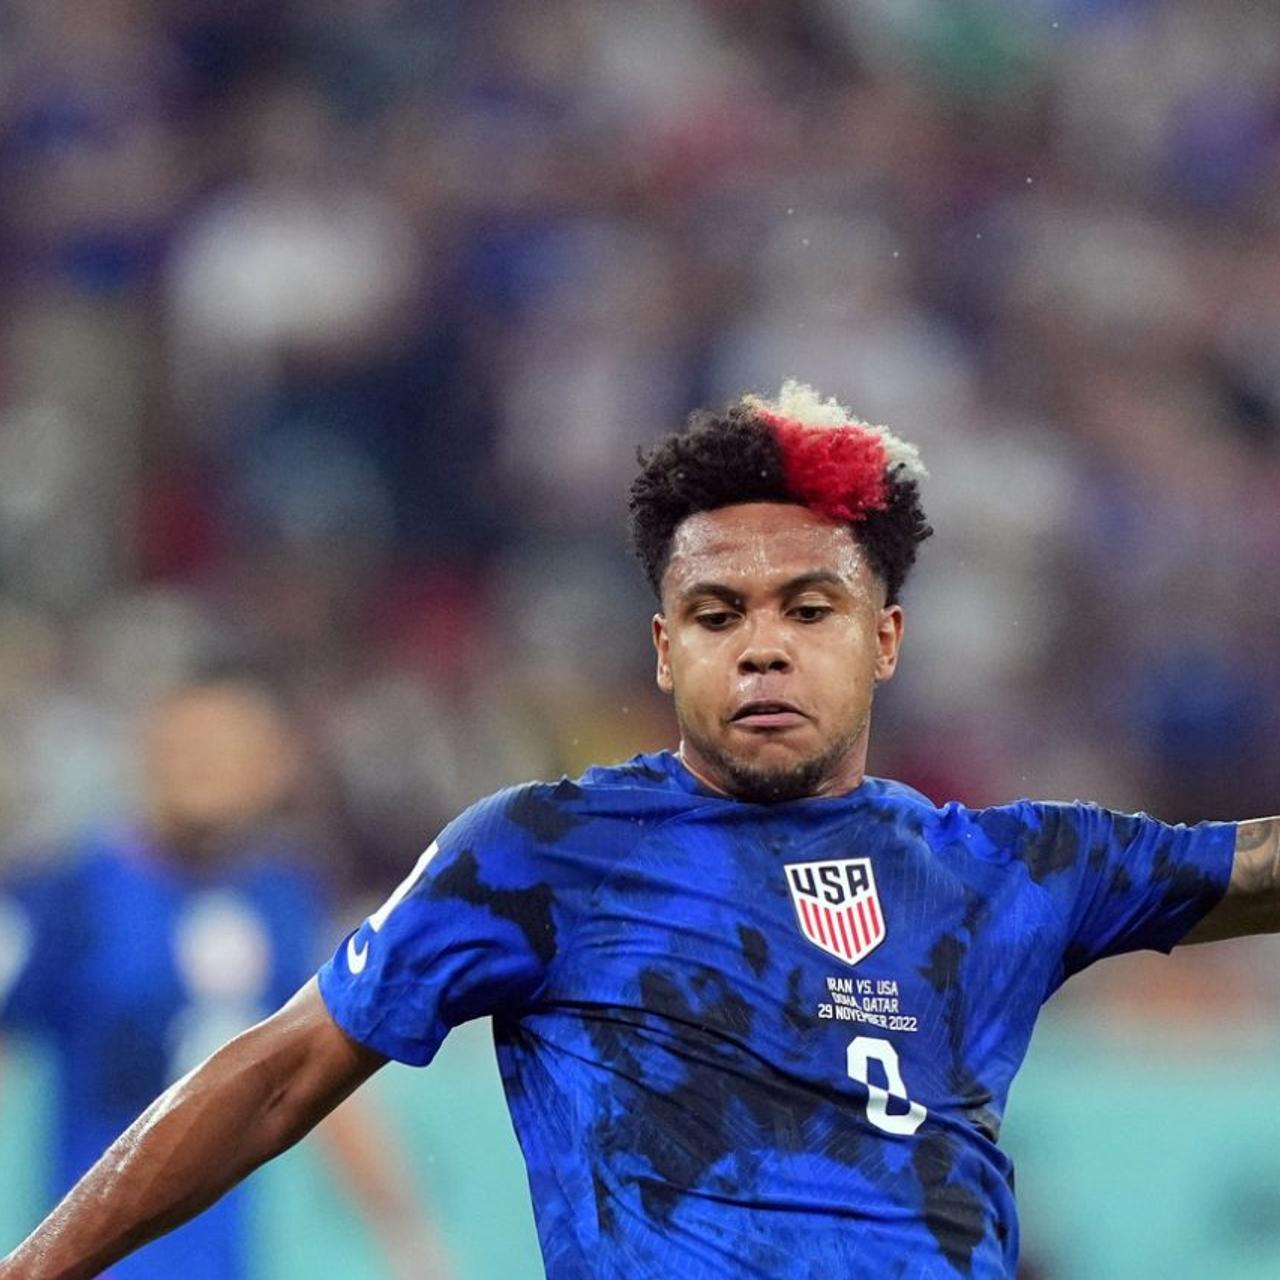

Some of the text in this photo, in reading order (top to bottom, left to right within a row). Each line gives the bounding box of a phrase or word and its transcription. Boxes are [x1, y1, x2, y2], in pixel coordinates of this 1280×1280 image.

[790, 864, 871, 906] USA
[826, 977, 899, 996] IRAN VS. USA
[862, 997, 899, 1013] QATAR
[818, 1003, 918, 1032] 29 NOVEMBER 2022
